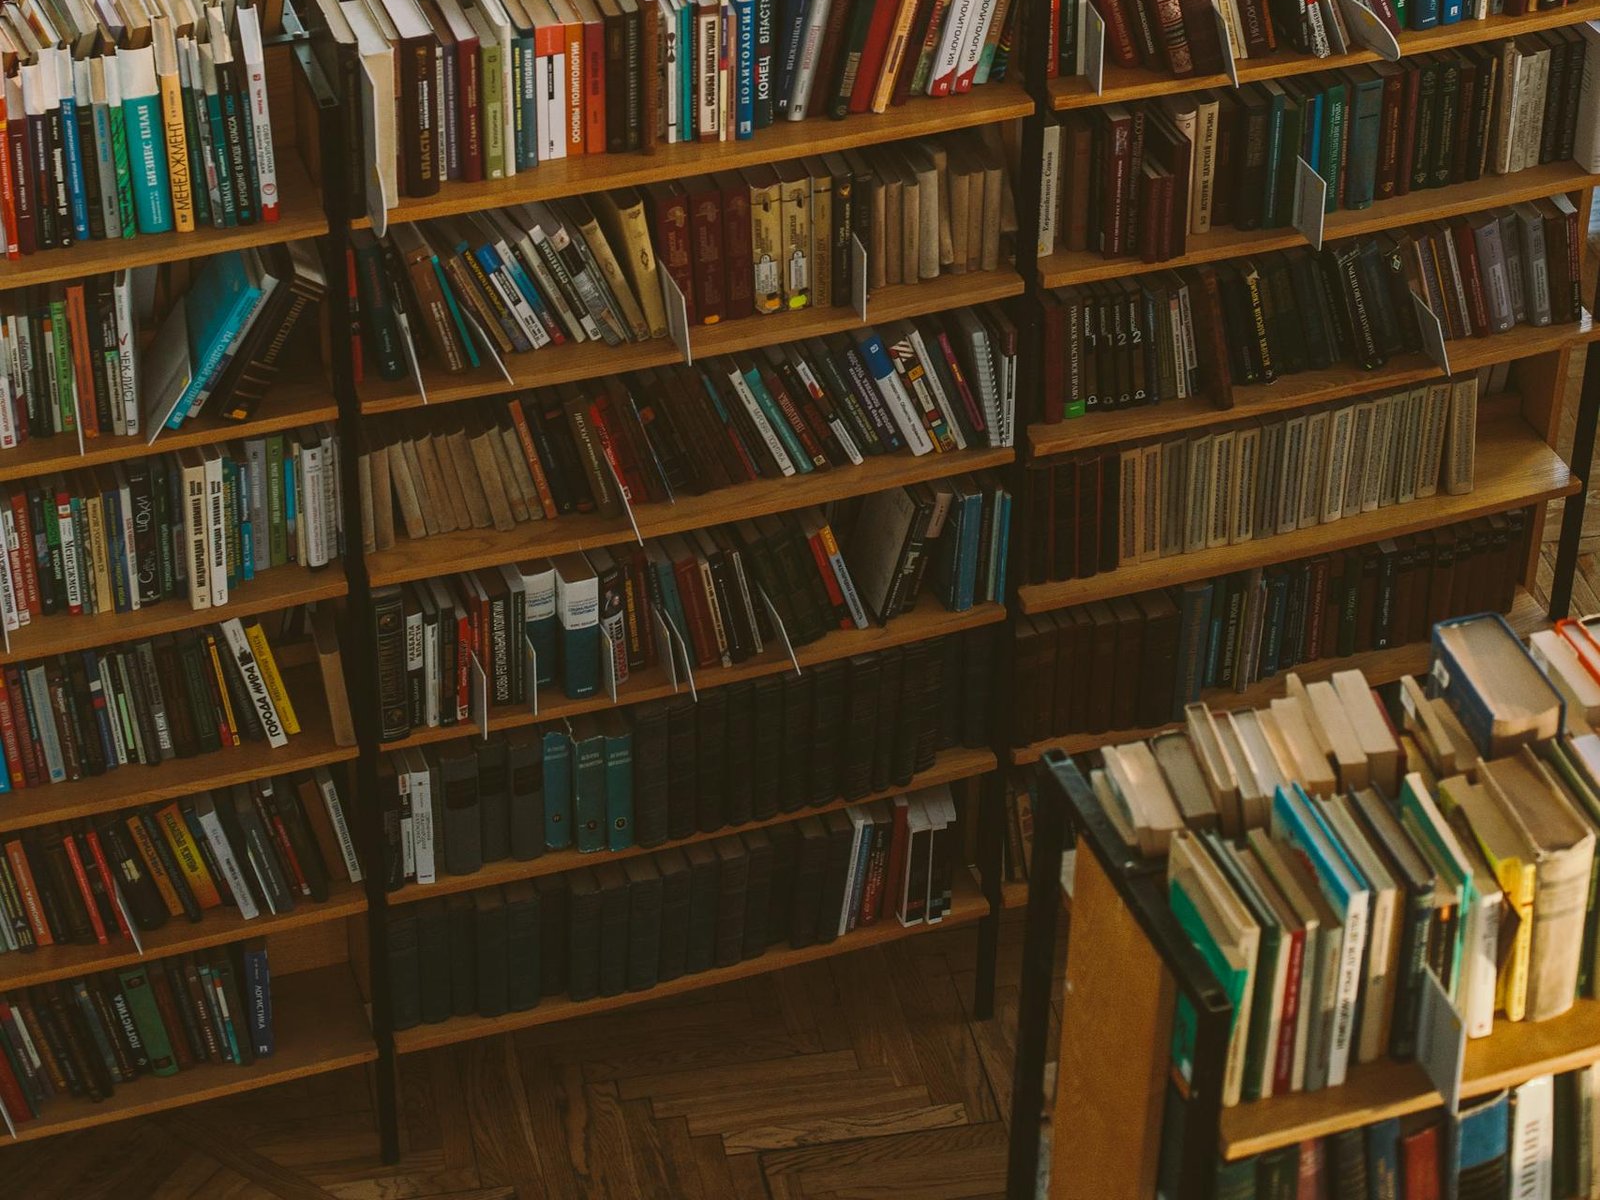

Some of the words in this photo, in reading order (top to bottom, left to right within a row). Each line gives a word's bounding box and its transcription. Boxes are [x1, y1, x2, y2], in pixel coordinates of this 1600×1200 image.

[946, 0, 971, 65] ПОЛИТОЛОГИЯ
[523, 49, 533, 99] ПОЛИТОЛОГИЯ
[571, 41, 581, 105] ПОЛИТОЛОГИИ
[741, 7, 752, 104] ПОЛИТОЛОГИЯ
[758, 56, 771, 99] КОНЕЦ
[138, 105, 151, 138] ПЛАН
[571, 107, 581, 143] ОСНОВЫ
[142, 140, 158, 186] БИЗНЕС
[167, 122, 190, 211] МЕНЕДЖМЕНТ
[420, 131, 431, 180] ВЛАСТЬ
[218, 330, 233, 343] НА
[1132, 330, 1141, 344] 2
[120, 351, 133, 403] ЧЕК-ЛИСТ
[201, 344, 225, 375] ОДНОЙ
[18, 506, 30, 559] ЭКОНОМИКА
[26, 563, 36, 602] МИРОВАЯ
[493, 600, 504, 630] ПОЛИТИКИ
[494, 631, 506, 675] РЕГИОНАЛЬНОЙ
[248, 666, 265, 695] МИРА
[496, 675, 509, 700] ОСНОВЫ
[257, 697, 280, 737] ГОРОДА
[113, 994, 140, 1048] ЛОГИСТИКА
[254, 985, 266, 1029] ЛОГИСТИКА
